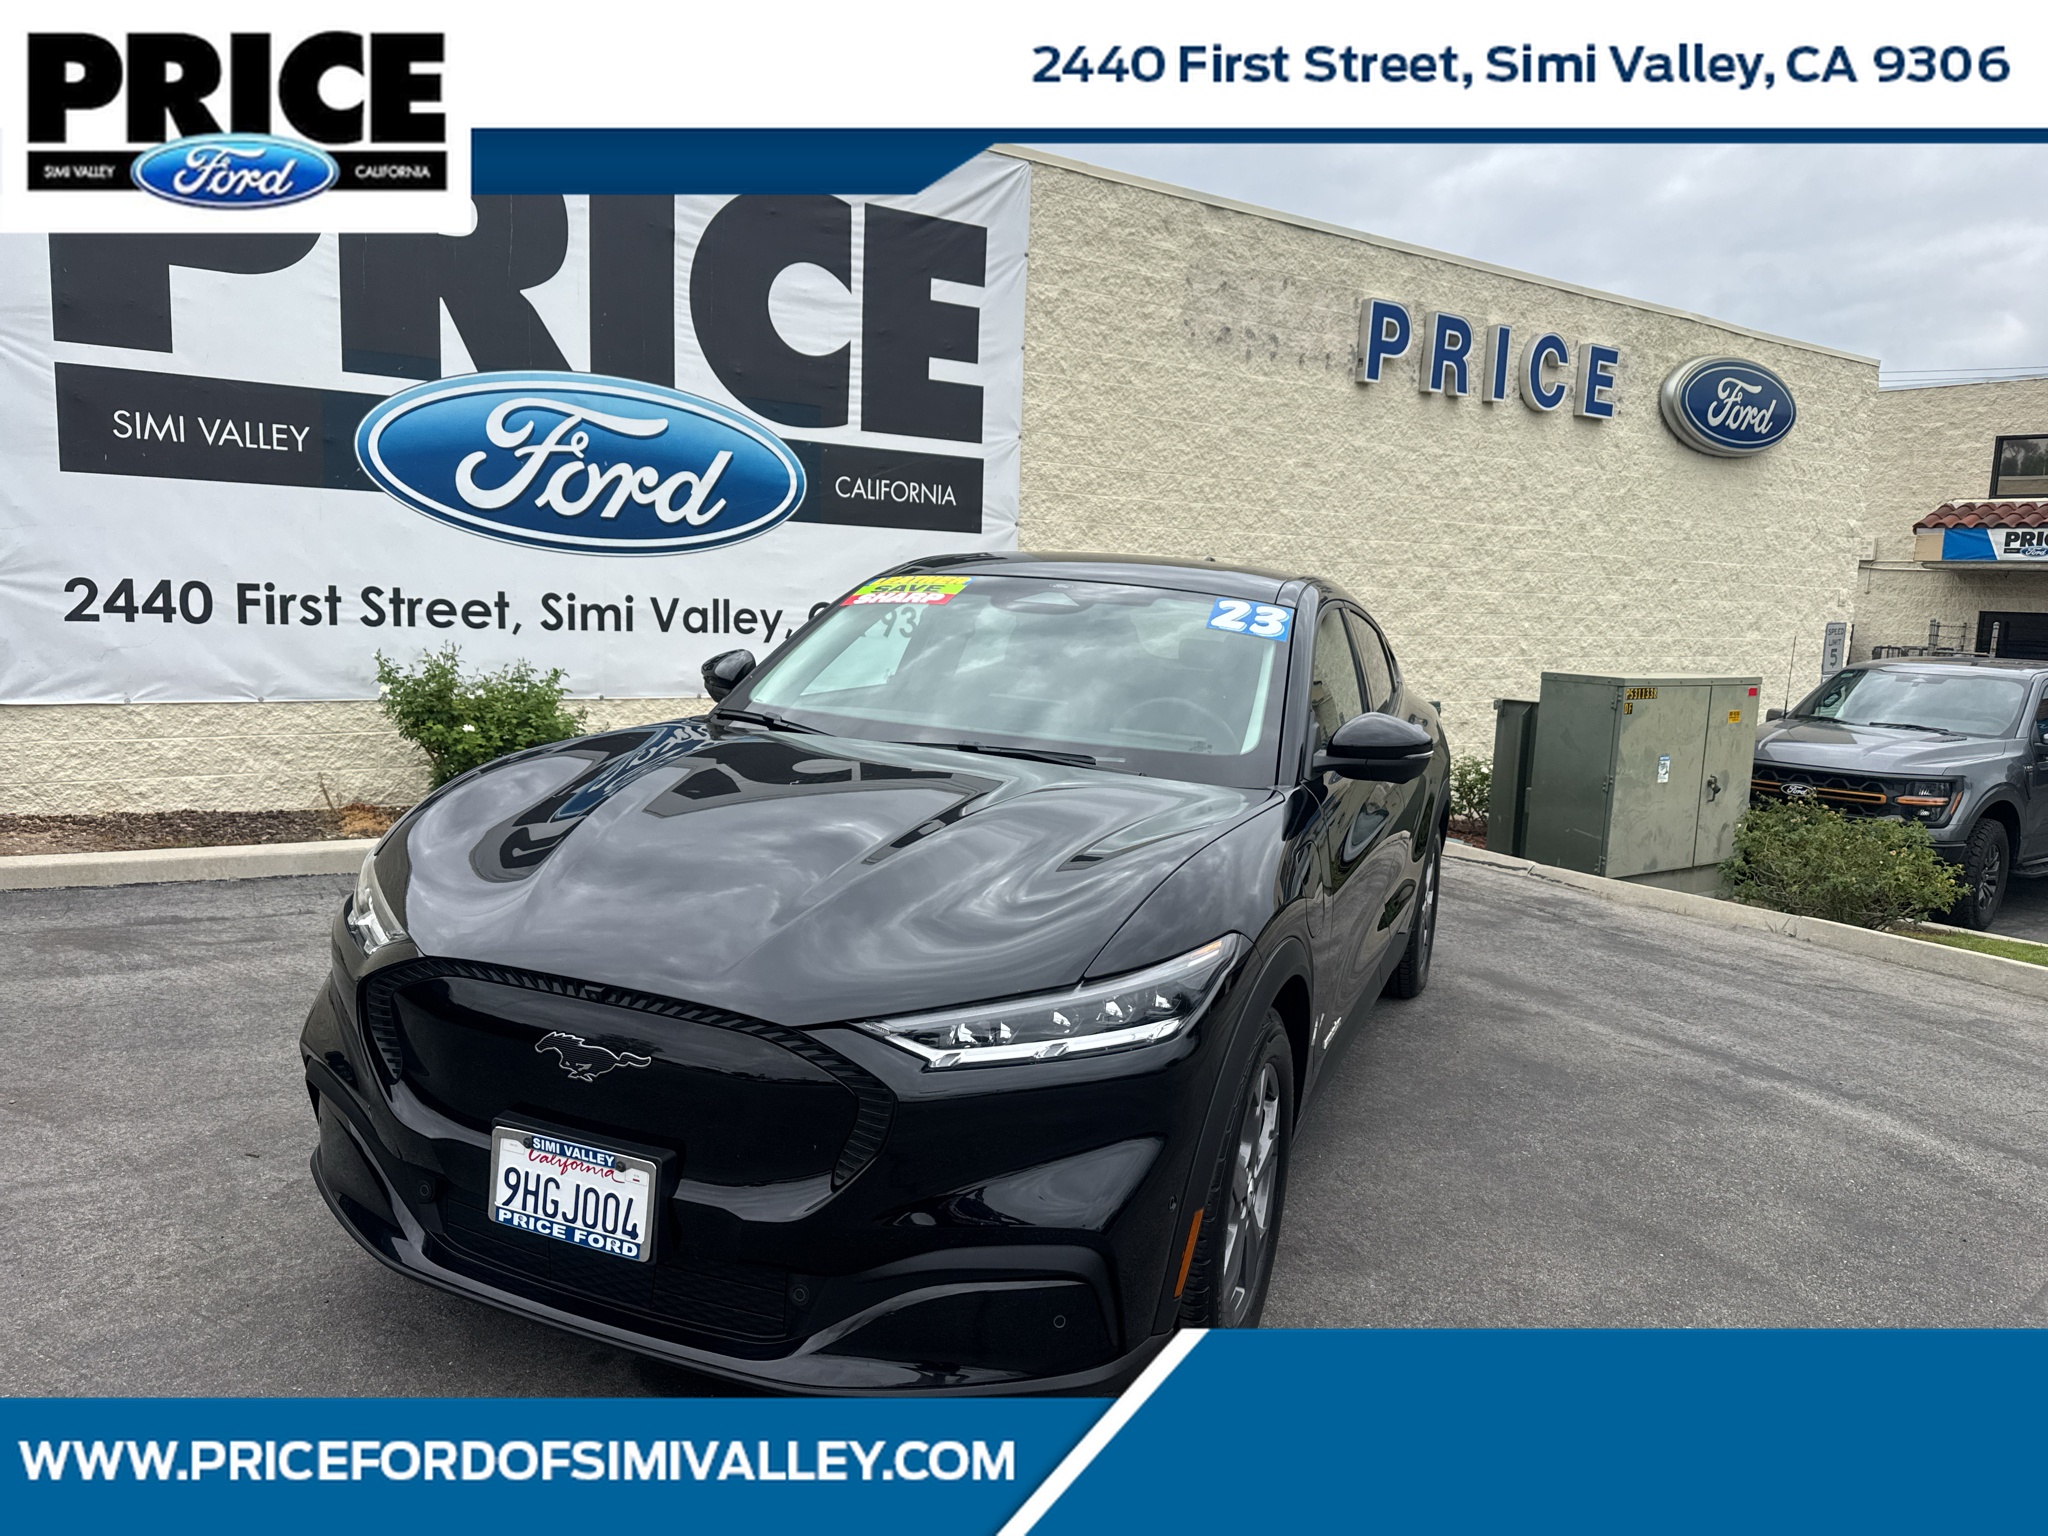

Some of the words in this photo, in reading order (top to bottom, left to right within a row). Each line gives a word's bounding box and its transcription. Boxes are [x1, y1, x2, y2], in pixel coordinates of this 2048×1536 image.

[1358, 298, 1621, 419] PRICE
[1707, 376, 1776, 435] Ford
[112, 409, 185, 442] SIMI
[197, 417, 310, 452] VALLEY
[455, 397, 733, 528] Ford
[835, 475, 957, 506] CALIFORNIA
[2004, 531, 2048, 547] PRI
[853, 592, 945, 605] SHARP
[871, 584, 945, 594] SAVE
[64, 577, 213, 625] 2440
[236, 581, 342, 626] First
[360, 586, 522, 635] Street,
[540, 592, 634, 632] Simi
[650, 597, 794, 643] Valley,
[1210, 600, 1290, 638] 23
[1828, 627, 1844, 636] SPEED
[1829, 648, 1838, 668] 5
[528, 1149, 625, 1184] California
[533, 1137, 561, 1154] SIMI
[563, 1144, 615, 1167] VALLEY
[501, 1166, 640, 1241] 9HGJ004
[498, 1208, 566, 1239] PRICE
[573, 1229, 638, 1258] FORD
